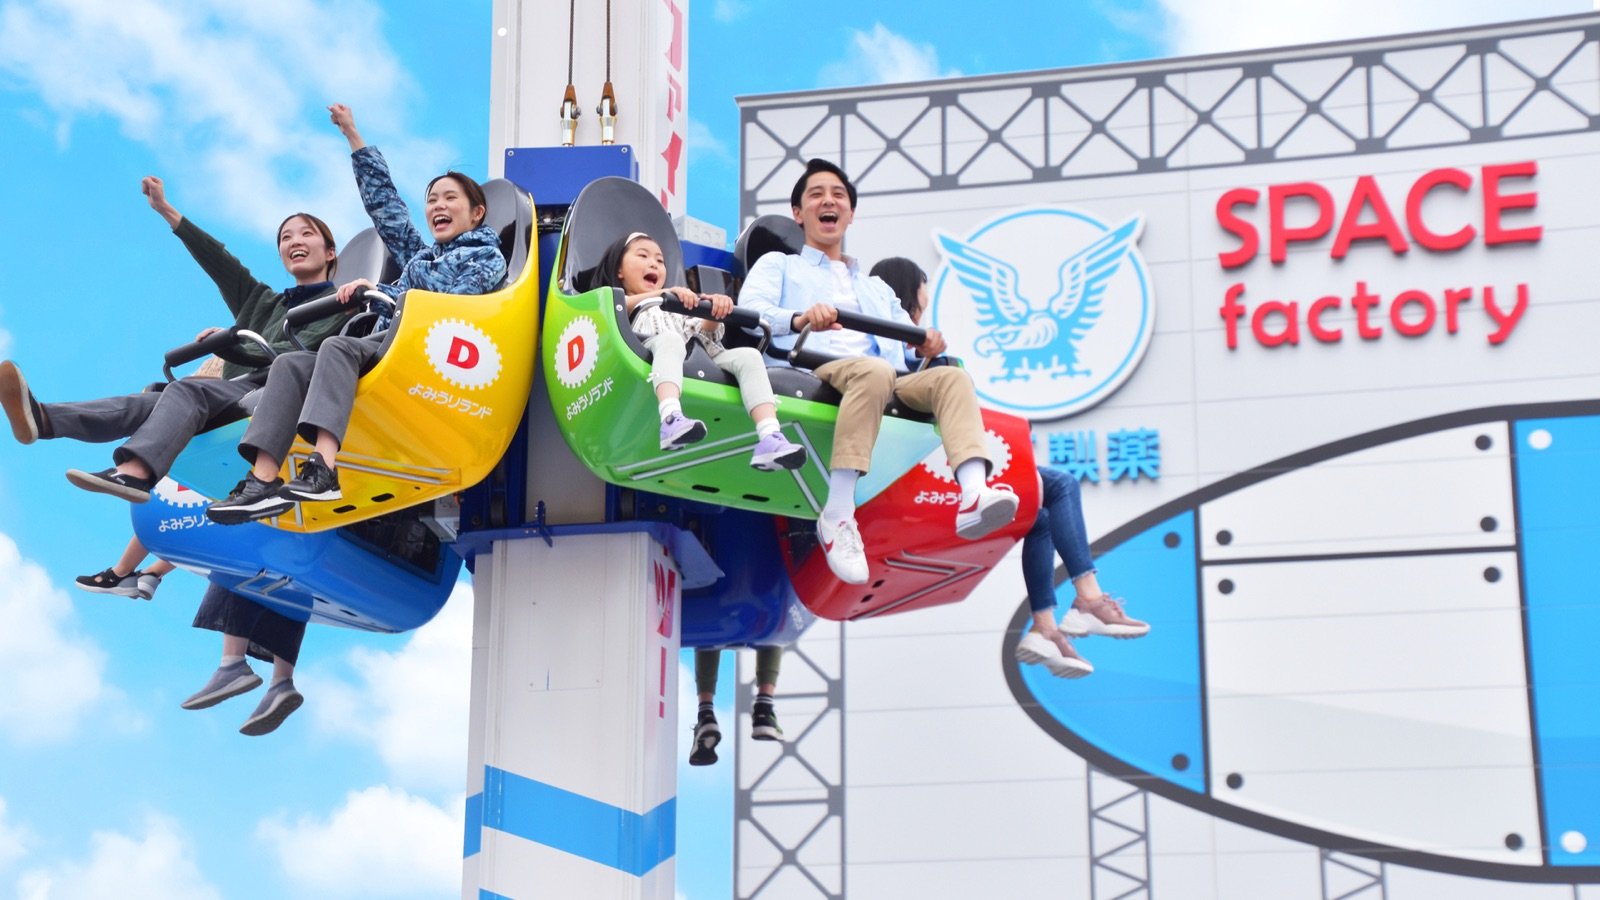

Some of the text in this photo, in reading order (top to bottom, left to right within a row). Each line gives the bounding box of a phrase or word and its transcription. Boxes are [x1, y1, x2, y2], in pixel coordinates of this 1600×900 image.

[1216, 160, 1543, 270] SPACE
[1219, 281, 1529, 350] factory
[446, 336, 480, 370] D
[567, 335, 585, 373] D
[408, 383, 493, 420] よみうりランド
[566, 376, 615, 421] よみうりランド
[1032, 427, 1160, 484] 製薬
